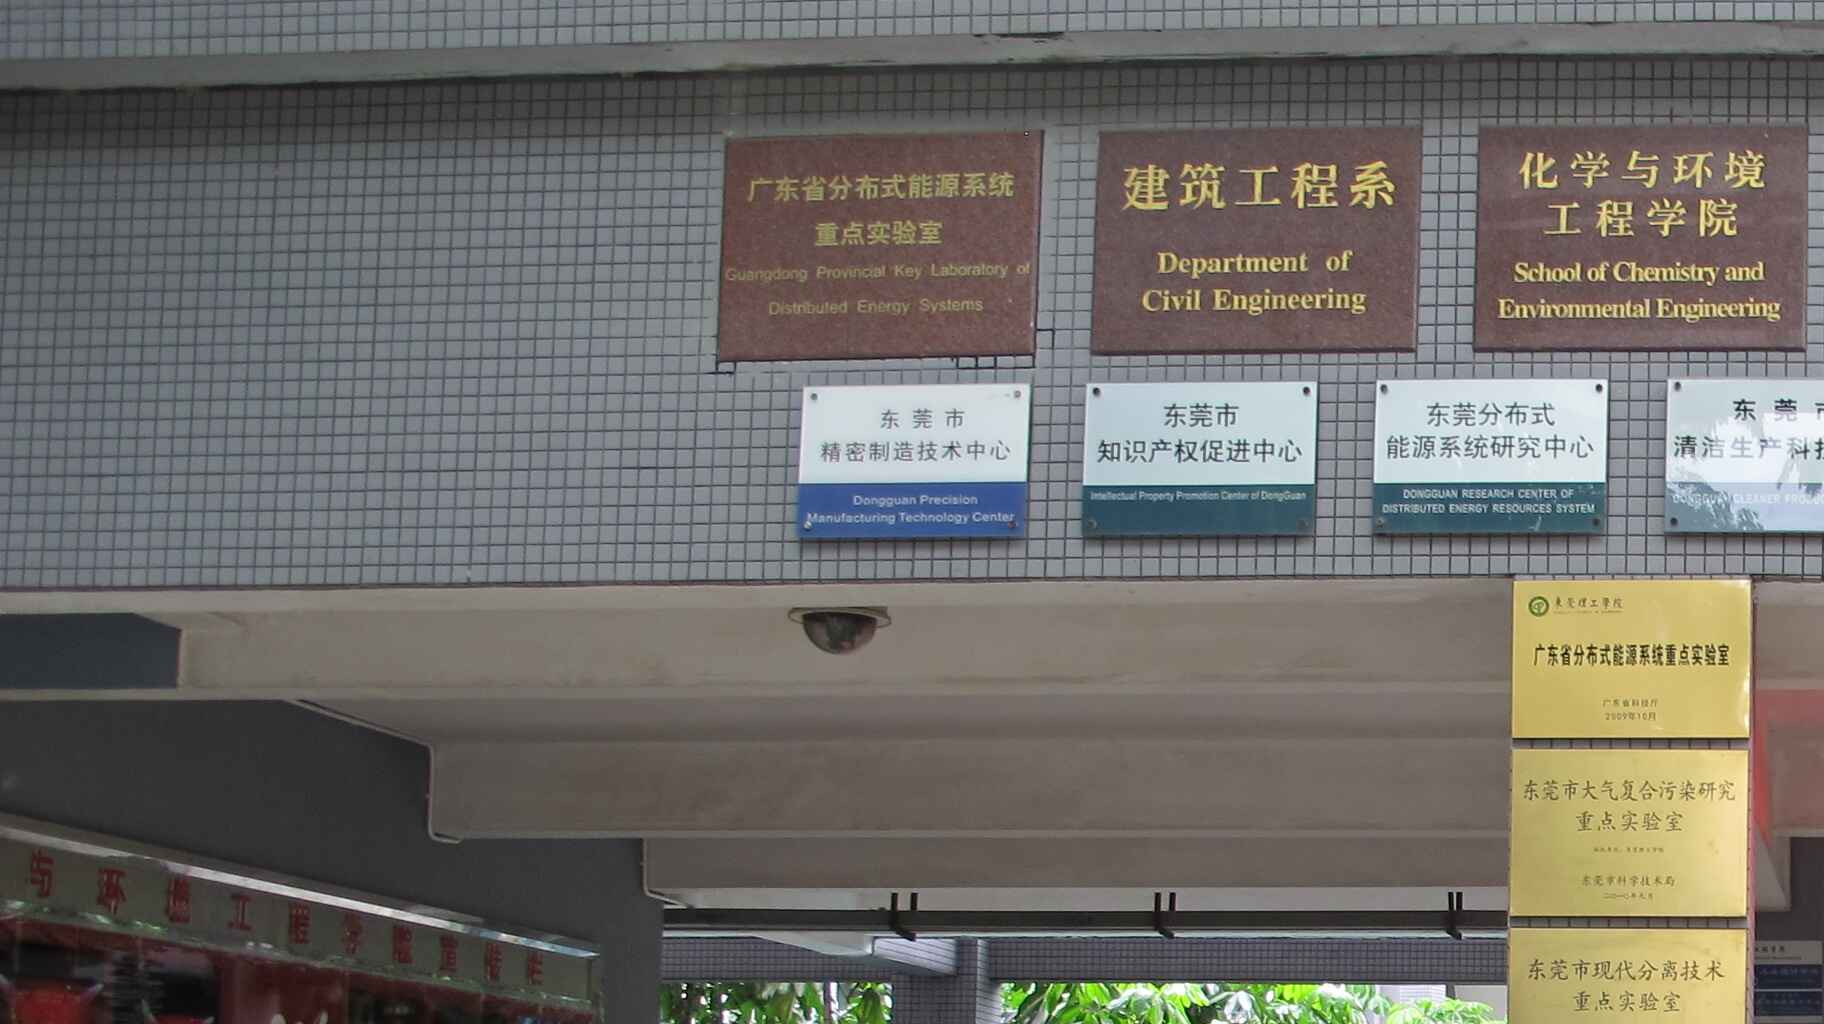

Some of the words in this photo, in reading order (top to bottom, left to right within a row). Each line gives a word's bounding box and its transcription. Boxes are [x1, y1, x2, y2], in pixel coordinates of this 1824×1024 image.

[1519, 150, 1766, 189] 化学与环境
[748, 171, 1015, 202] 广东省分布式能源系统
[1121, 160, 1396, 210] 建筑工程系
[1544, 198, 1738, 237] 工程学院
[814, 219, 943, 247] 重点实验室
[725, 267, 808, 283] Guangdong
[816, 265, 886, 280] Provincial
[895, 264, 922, 280] Key
[931, 262, 1008, 278] Laboratory
[1016, 262, 1031, 276] of
[1157, 252, 1308, 279] Department
[1326, 251, 1352, 272] of
[1514, 262, 1582, 283] School
[1587, 262, 1610, 282] of
[1613, 262, 1719, 286] Chemistry
[1725, 262, 1765, 282] and
[768, 300, 848, 315] Distributed
[857, 299, 910, 315] Energy
[919, 298, 984, 313] Systems
[1143, 288, 1201, 311] Civil
[1213, 288, 1367, 315] Engineering
[1498, 298, 1650, 319] Environmental
[1656, 298, 1780, 322] Engineering
[880, 408, 965, 429] 东莞市
[1163, 403, 1240, 428] 东莞市
[1427, 402, 1556, 427] 东莞分布式
[820, 440, 1010, 463] 精密制造技术中心
[1097, 439, 1303, 463] 知识产权促进中心
[1386, 434, 1594, 460] 能源系统研究中心
[853, 495, 917, 508] Dongguan
[920, 494, 978, 505] Precision
[1090, 491, 1137, 500] Intellectual
[1139, 491, 1174, 502] Property
[1176, 491, 1219, 500] Promotion
[1221, 491, 1248, 500] Center
[1249, 491, 1260, 500] of
[1402, 489, 1458, 499] DONGGUAN
[1462, 488, 1514, 499] RESEARCH
[1517, 488, 1557, 499] CENTER
[1560, 488, 1574, 498] OF
[806, 512, 896, 525] Manufacturing
[898, 512, 969, 525] Technology
[972, 511, 1015, 523] Center
[1382, 503, 1445, 514] DISTRIBUTED
[1449, 503, 1488, 514] ENERGY
[1492, 503, 1552, 514] RESOURCES
[1555, 503, 1595, 514] SYSTEM
[1533, 643, 1729, 667] 广东省分布式能源系统重点实验室
[1523, 779, 1736, 801] 东莞市大气复合污染研究
[1576, 811, 1683, 832] 重点实验室
[1528, 959, 1725, 981] 东莞市现代分离技术
[1573, 991, 1681, 1012] 重点实验室
